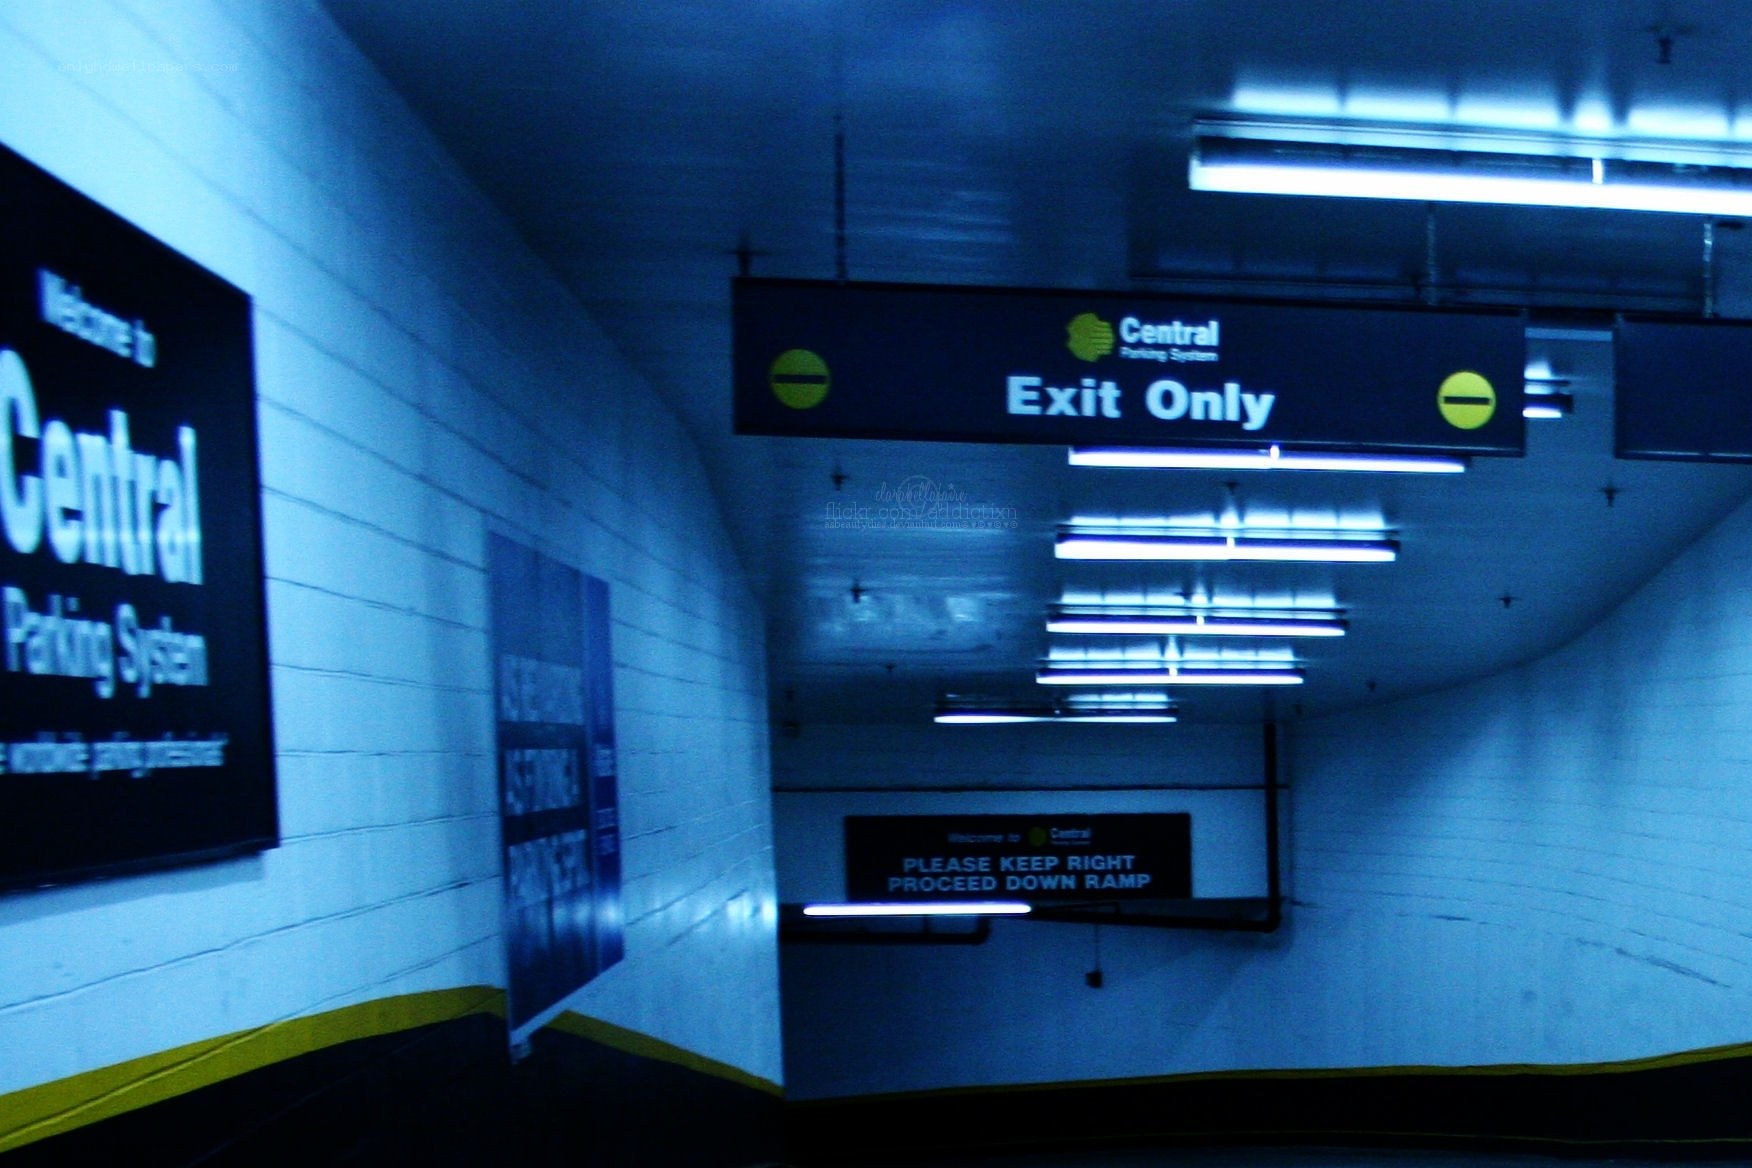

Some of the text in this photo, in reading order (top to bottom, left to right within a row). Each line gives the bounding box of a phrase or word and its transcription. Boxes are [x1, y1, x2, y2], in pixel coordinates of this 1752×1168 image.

[1119, 316, 1219, 346] Central
[1006, 375, 1275, 430] Exit Only
[0, 348, 203, 585] Central
[4, 586, 209, 698] Parking System
[888, 874, 1151, 893] PROCEED DOWN RAMP
[903, 855, 1136, 873] PLEASE KEEP RIGHT
